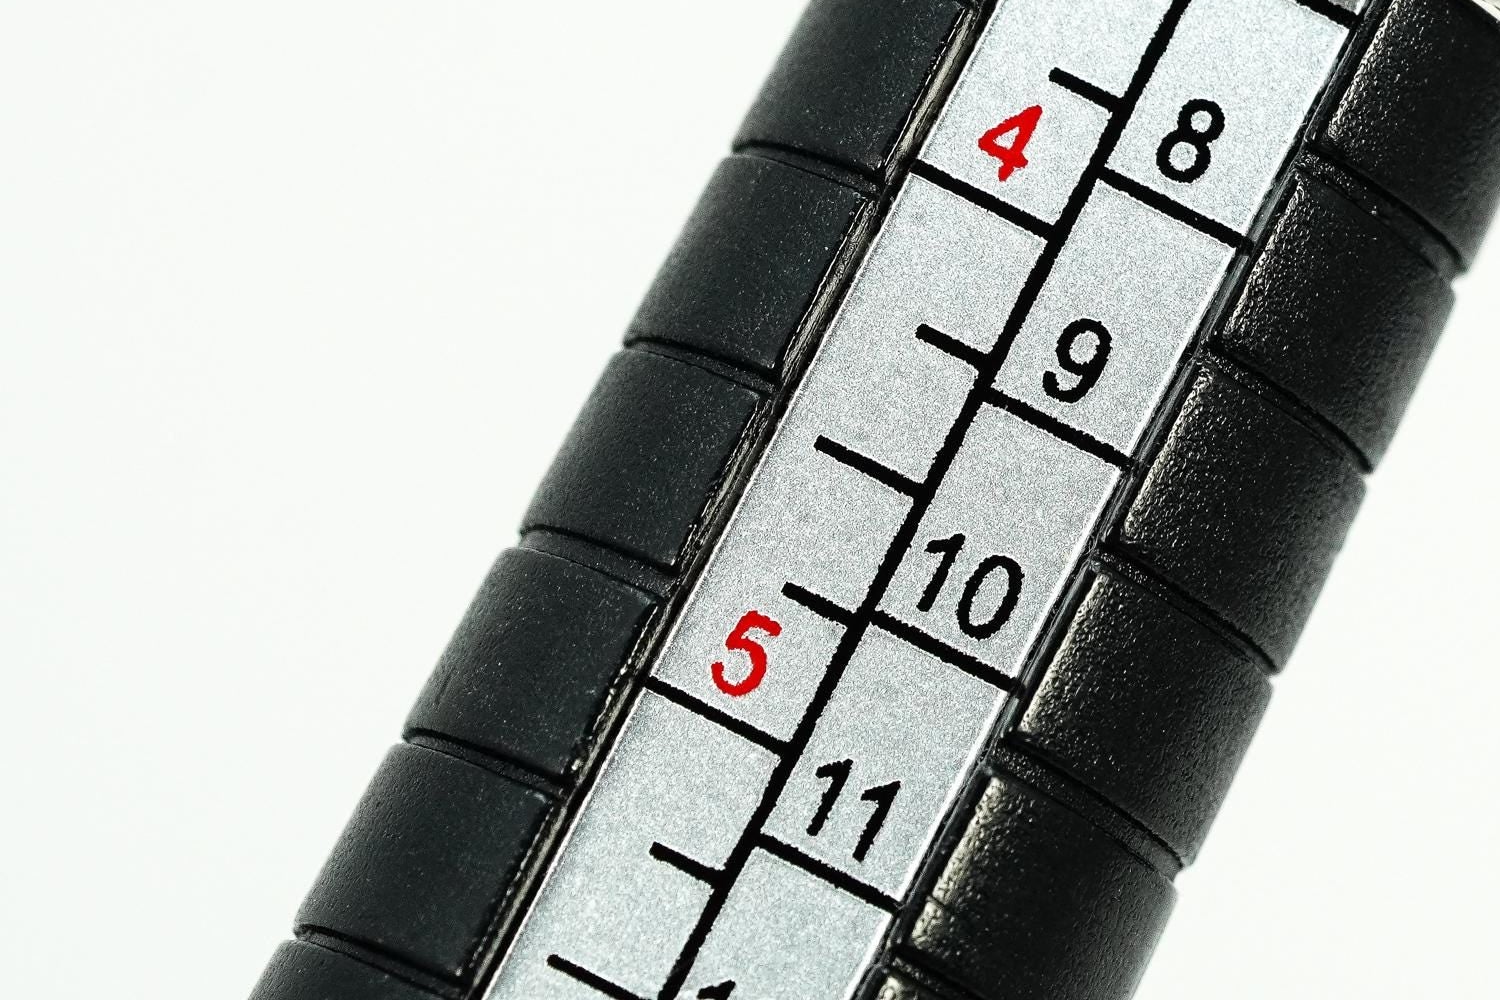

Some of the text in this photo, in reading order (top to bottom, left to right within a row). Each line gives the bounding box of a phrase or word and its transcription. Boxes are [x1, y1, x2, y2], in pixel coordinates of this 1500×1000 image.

[977, 104, 1044, 183] 4
[1155, 98, 1226, 184] 8
[1041, 317, 1114, 404] 9
[915, 532, 1026, 643] 10
[710, 609, 783, 698] 5
[805, 758, 901, 864] 11
